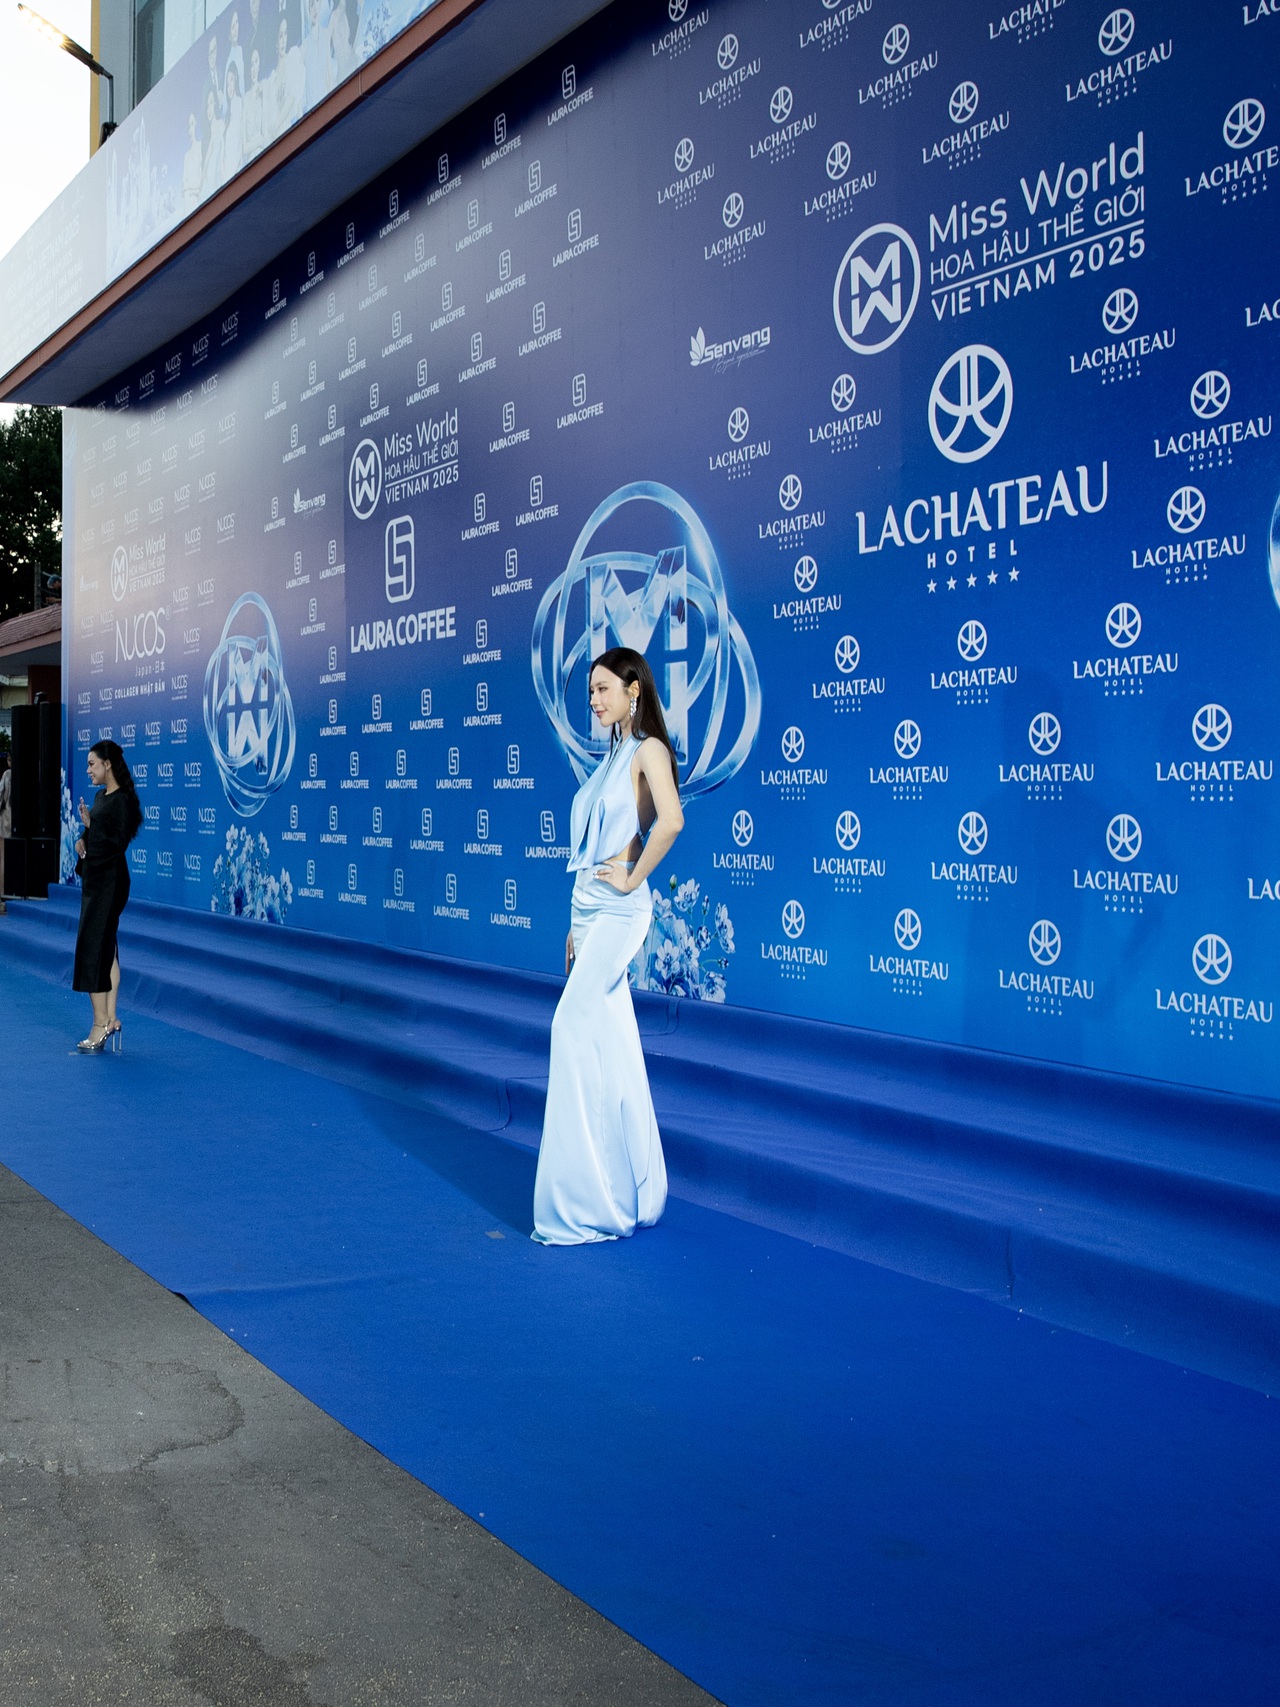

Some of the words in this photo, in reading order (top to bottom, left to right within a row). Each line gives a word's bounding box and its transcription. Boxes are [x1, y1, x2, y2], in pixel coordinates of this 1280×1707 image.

[652, 9, 709, 56] LACHATEAU
[799, 0, 872, 48] LACHATEAU
[989, 0, 1066, 40] LACHAT
[699, 58, 761, 105] LACHATEAU
[858, 50, 938, 105] LACHATEAU
[1066, 39, 1172, 102] LACHATEAU
[1097, 75, 1136, 99] HOTEL
[547, 104, 568, 126] LAURA
[567, 87, 593, 114] COFFEE
[750, 112, 816, 159] LACHATEAU
[922, 111, 1009, 164] LACHATEAU
[658, 163, 714, 204] LACHATEAU
[1184, 145, 1280, 197] LACHATE
[1221, 173, 1267, 196] HOTEL
[515, 199, 534, 217] LAURA
[534, 184, 557, 206] COFFEE
[804, 170, 876, 216] LACHATEAU
[930, 198, 1007, 252] Miss
[1020, 130, 1144, 215] World
[704, 220, 765, 260] LACHATEAU
[930, 249, 975, 285] HOA
[982, 227, 1029, 267] HẬU
[1038, 198, 1085, 246] THẾ
[1093, 184, 1145, 227] GIỚI
[553, 248, 573, 267] LAURA
[573, 234, 599, 256] COFFEE
[931, 258, 1055, 321] VIETNAM
[1069, 228, 1145, 279] 2025
[519, 339, 538, 356] LAURA
[538, 328, 562, 347] COFFEE
[700, 326, 770, 365] Senvang
[1069, 328, 1175, 374] LACHATEAU
[1101, 359, 1139, 376] HOTEL
[557, 412, 578, 429] LAURA
[578, 402, 604, 421] COFFEE
[809, 409, 881, 443] LACHATEAU
[384, 431, 412, 462] Miss
[416, 407, 458, 448] World
[1154, 415, 1272, 458] LACHATEAU
[385, 463, 402, 482] HOA
[403, 453, 420, 474] HẬU
[422, 442, 439, 468] THẾ
[441, 439, 459, 461] GIỚI
[709, 440, 770, 470] LACHATEAU
[1189, 446, 1232, 462] HOTEL
[385, 475, 429, 504] VIETNAM
[433, 465, 459, 489] 2025
[516, 511, 535, 526] LAURA
[534, 504, 559, 521] COFFEE
[855, 460, 1108, 554] LACHATEAU
[759, 510, 825, 539] LACHATEAU
[129, 544, 145, 561] Miss
[145, 533, 165, 555] World
[927, 537, 1017, 571] HOTEL
[1131, 534, 1245, 569] LACHATEAU
[152, 571, 165, 587] 2025
[1165, 562, 1207, 575] HOTEL
[492, 583, 510, 597] LAURA
[510, 578, 533, 593] COFFEE
[773, 594, 841, 619] LACHATEAU
[351, 618, 393, 653] LAURA
[395, 605, 456, 647] COFFEE
[463, 652, 480, 665] LAURA
[479, 649, 501, 663] COFFEE
[1073, 653, 1178, 679] LACHATEAU
[115, 684, 139, 700] COLLAGEN
[140, 682, 153, 697] NHẬT
[155, 680, 165, 694] BẢN
[812, 677, 885, 699] LACHATEAU
[930, 666, 1017, 689] LACHATEAU
[1104, 677, 1142, 687] HOTEL
[463, 715, 481, 727] LAURA
[480, 714, 502, 726] COFFEE
[493, 778, 512, 789] LAURA
[511, 778, 534, 789] COFFEE
[761, 769, 828, 785] LACHATEAU
[869, 766, 948, 784] LACHATEAU
[999, 763, 1094, 782] LACHATEAU
[1155, 760, 1273, 781] LACHATEAU
[464, 843, 481, 854] LAURA
[480, 843, 502, 856] COFFEE
[525, 846, 547, 858] LAURA
[548, 847, 570, 859] COFFE
[713, 853, 774, 871] LACHATEAU
[813, 857, 885, 877] LACHATEAU
[931, 862, 1017, 884] LACHATEAU
[1073, 869, 1178, 894] LACHATEAU
[1104, 894, 1142, 903] HOTEL
[490, 913, 509, 926] LAURA
[508, 915, 531, 929] COFFEE
[761, 943, 827, 966] LACHATEAU
[869, 955, 948, 980] LACHATEAU
[999, 969, 1094, 999] LACHATEAU
[1027, 994, 1061, 1006] HOTEL
[1155, 989, 1273, 1023] LACHATEAU
[1190, 1017, 1232, 1030] HOTEL
